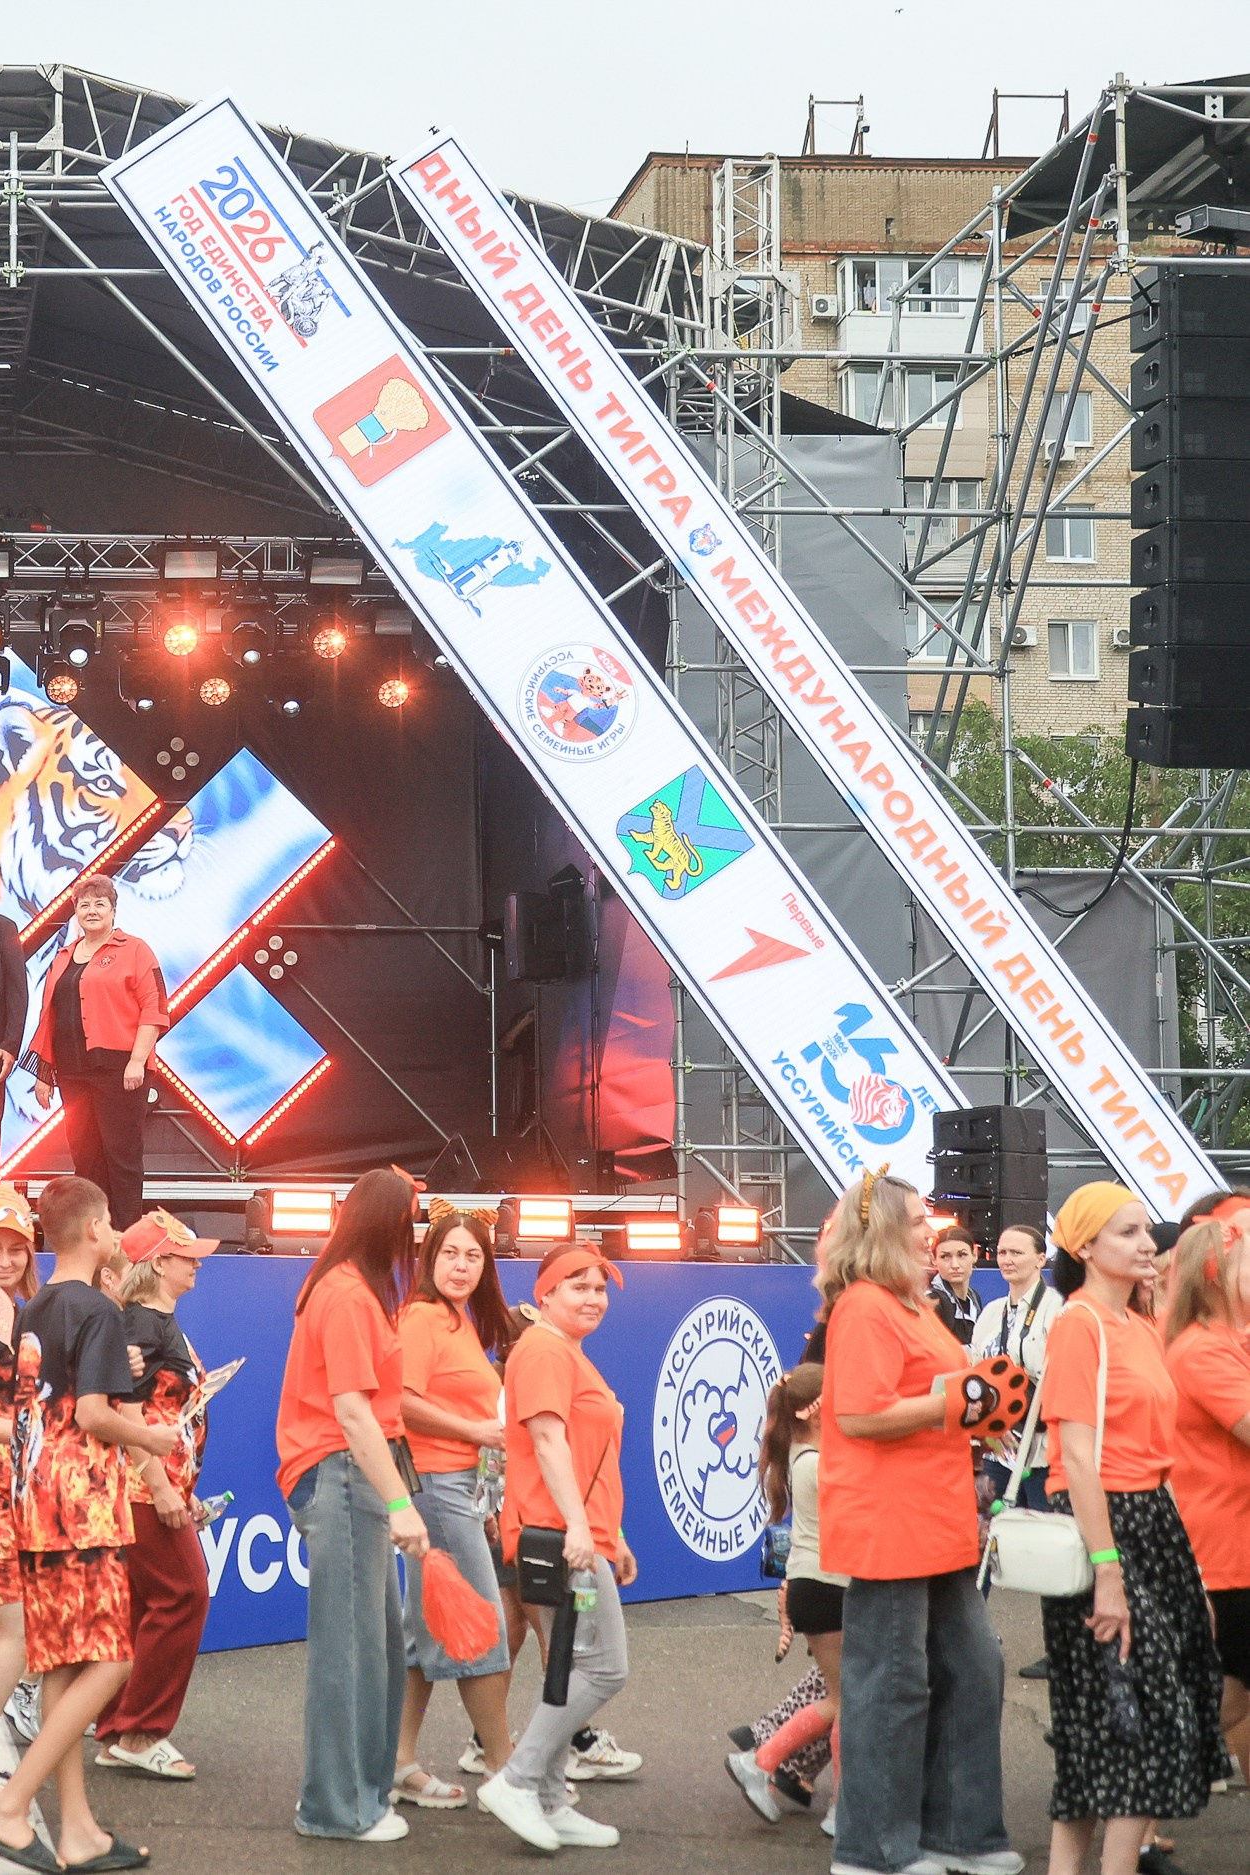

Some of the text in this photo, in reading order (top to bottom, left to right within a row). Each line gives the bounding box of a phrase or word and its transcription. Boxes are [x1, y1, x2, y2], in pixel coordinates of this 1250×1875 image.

[199, 165, 287, 264] 2026
[154, 205, 280, 373] НАРОДОВ РОССИИ
[170, 194, 274, 334] ГОД ЕДИНСТВА
[598, 652, 619, 677] 2026
[502, 281, 594, 394] ДЕНЬ
[595, 391, 693, 528] ТИГРА
[710, 556, 1010, 950] МЕЖДУНАРОДНЫЙ
[992, 950, 1089, 1069] ДЕНЬ
[1082, 1063, 1191, 1208] ТИГРА
[597, 722, 626, 750] ИГРЫ
[780, 891, 825, 949] Первые
[822, 1041, 839, 1061] 2026
[832, 1032, 849, 1054] 1866
[771, 1050, 864, 1173] УССУРИЙСК
[664, 1306, 778, 1391] УССУРИЙСКИЕ
[659, 1449, 745, 1554] СЕМЕЙНЫЕ
